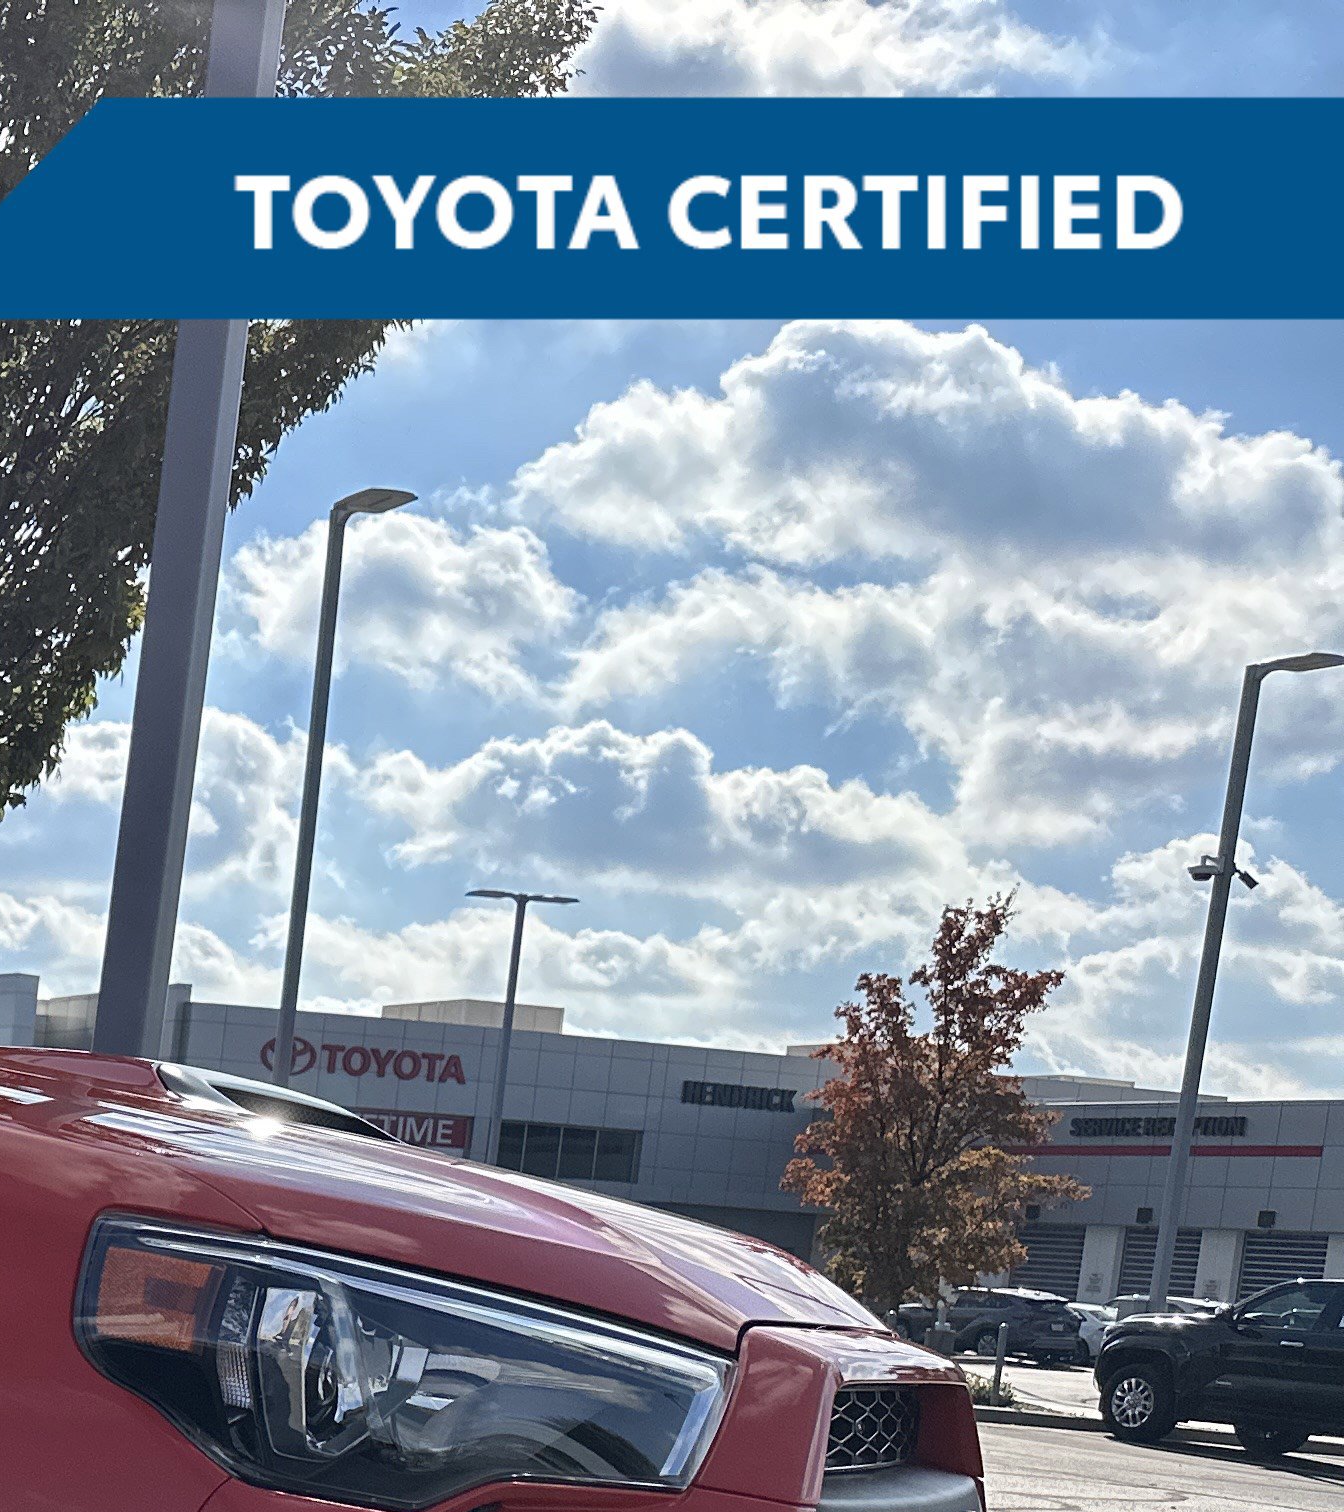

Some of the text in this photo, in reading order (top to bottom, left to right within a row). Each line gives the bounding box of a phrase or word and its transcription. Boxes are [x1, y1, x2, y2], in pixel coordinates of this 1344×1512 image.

[321, 1044, 466, 1085] TOYOTA
[681, 1080, 798, 1113] HENDRICK
[362, 1112, 455, 1144] TIME
[1143, 1115, 1248, 1137] RECPTION
